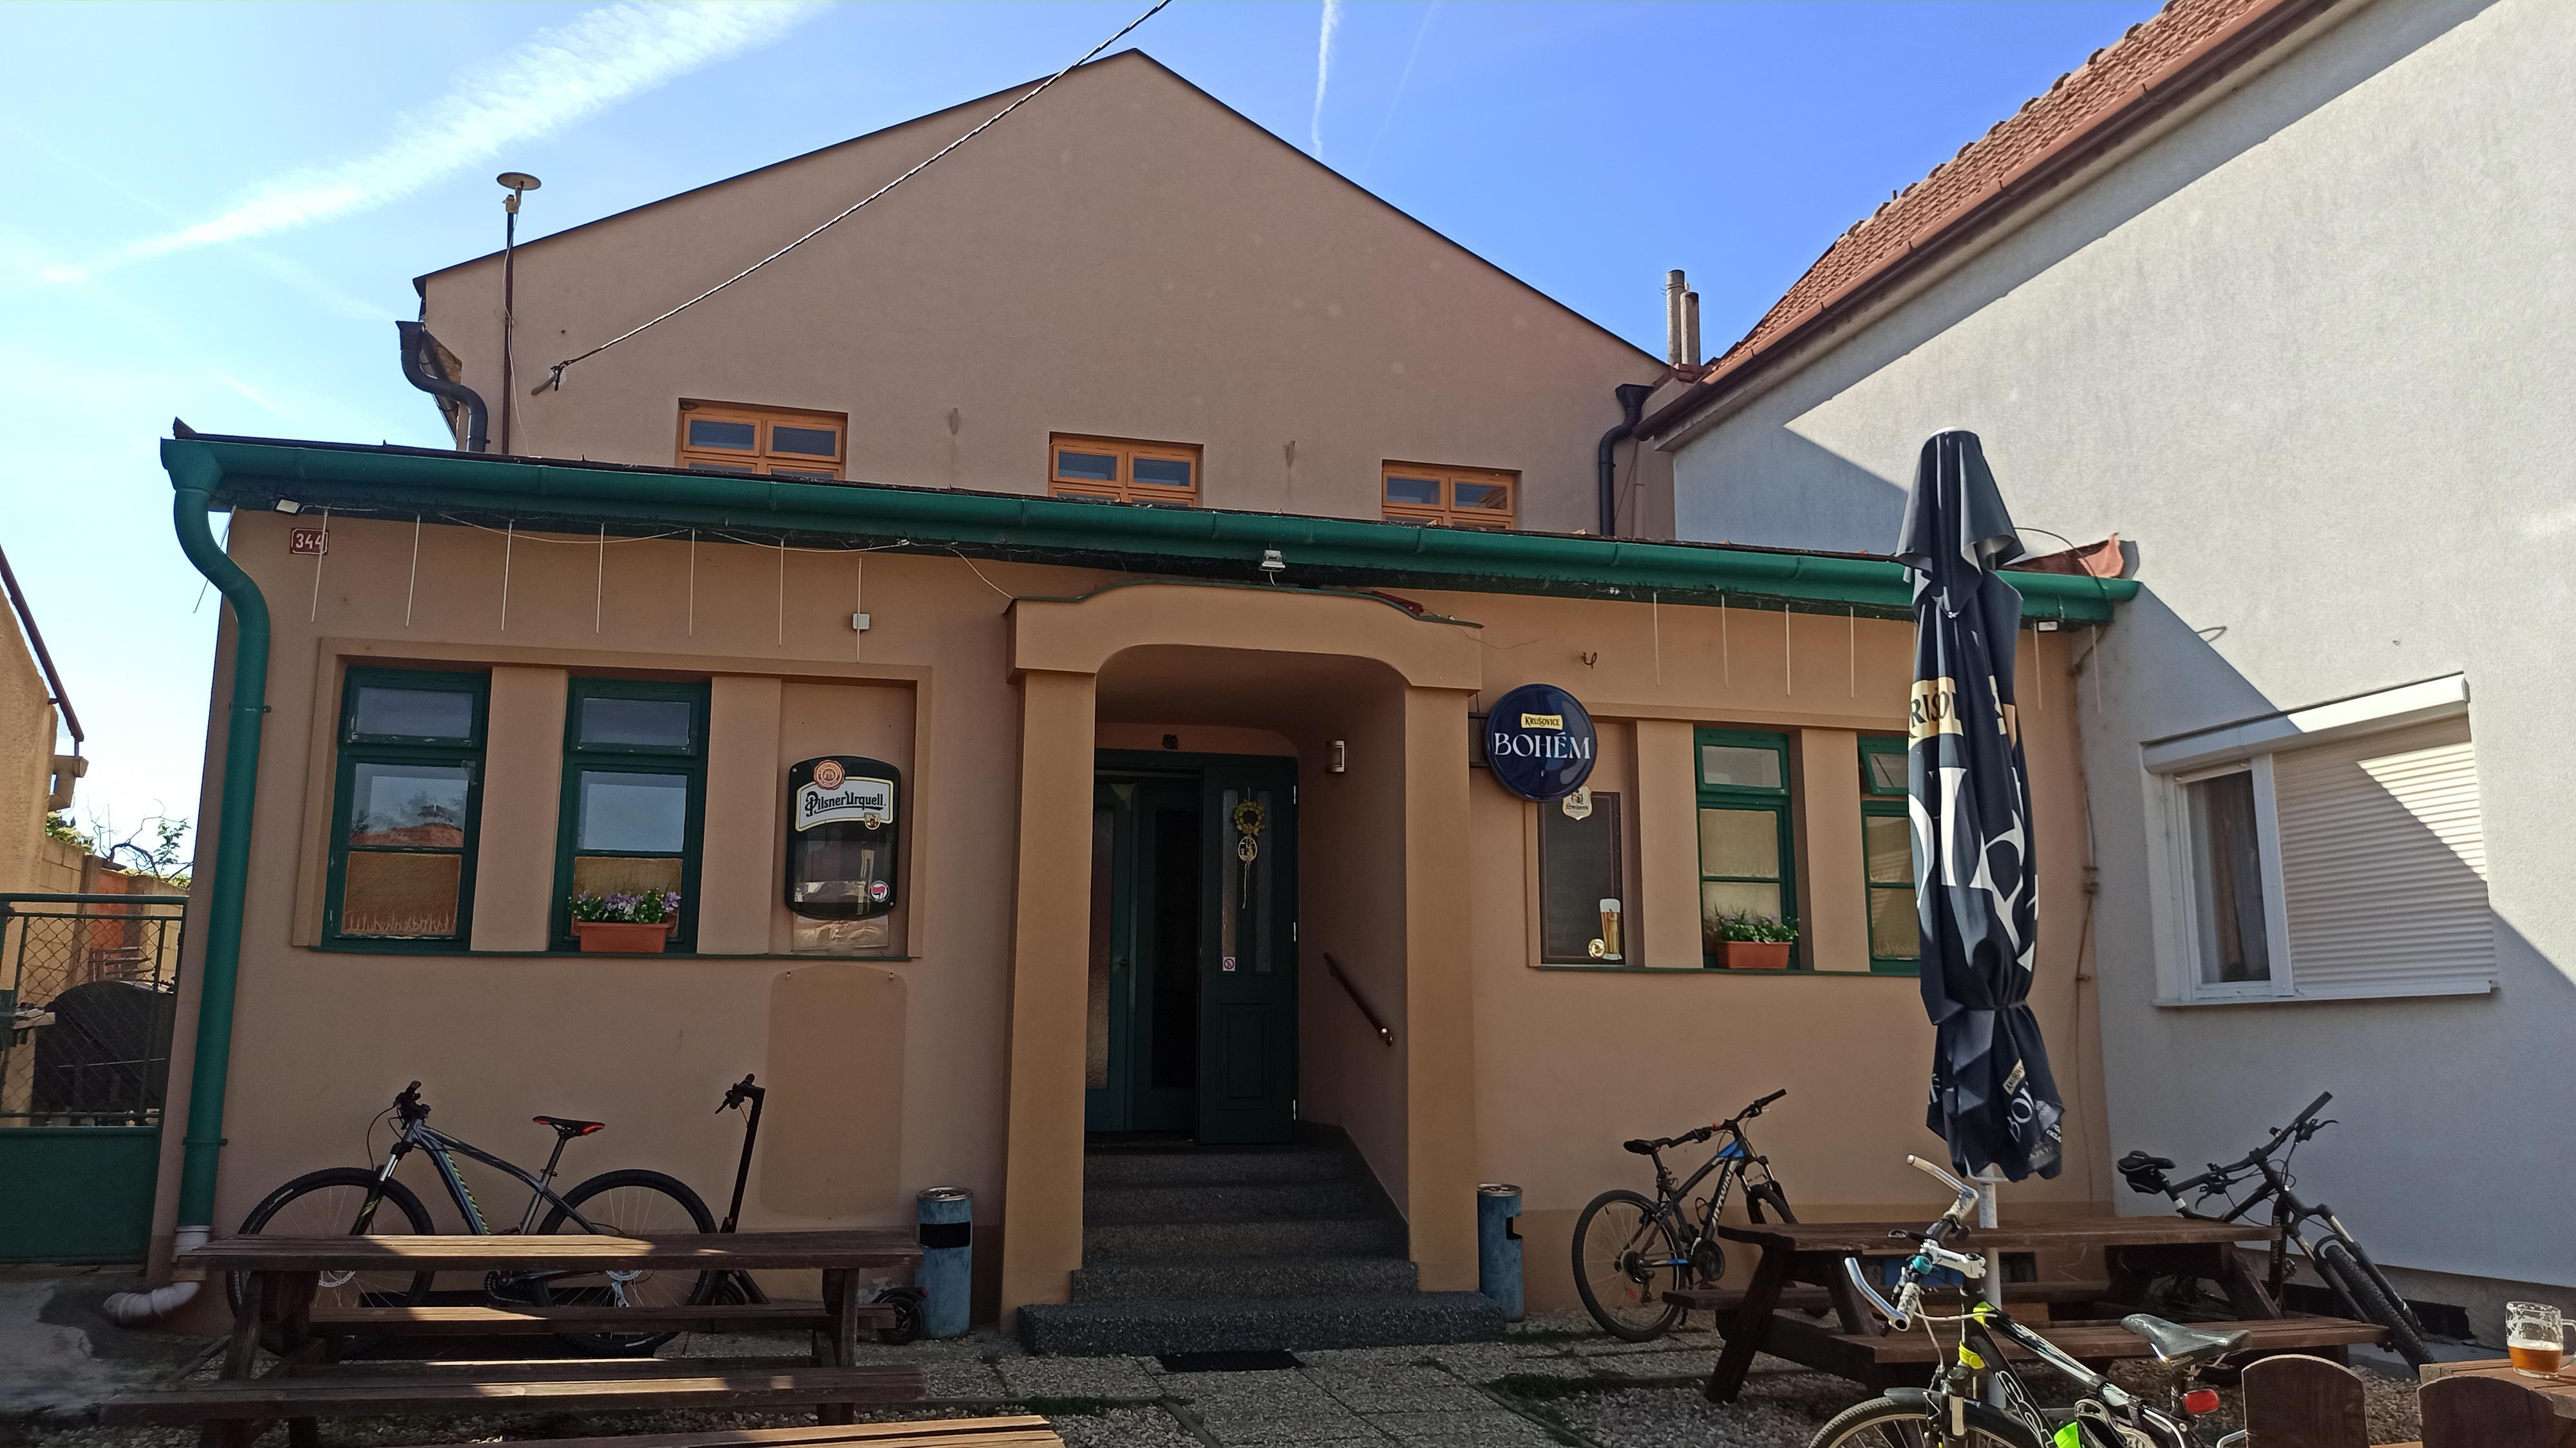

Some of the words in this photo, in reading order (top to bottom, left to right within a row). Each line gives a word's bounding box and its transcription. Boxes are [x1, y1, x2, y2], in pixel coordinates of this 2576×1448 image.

[296, 533, 322, 549] 344
[1494, 731, 1591, 759] BOHÉM
[805, 791, 846, 817] Pilsner
